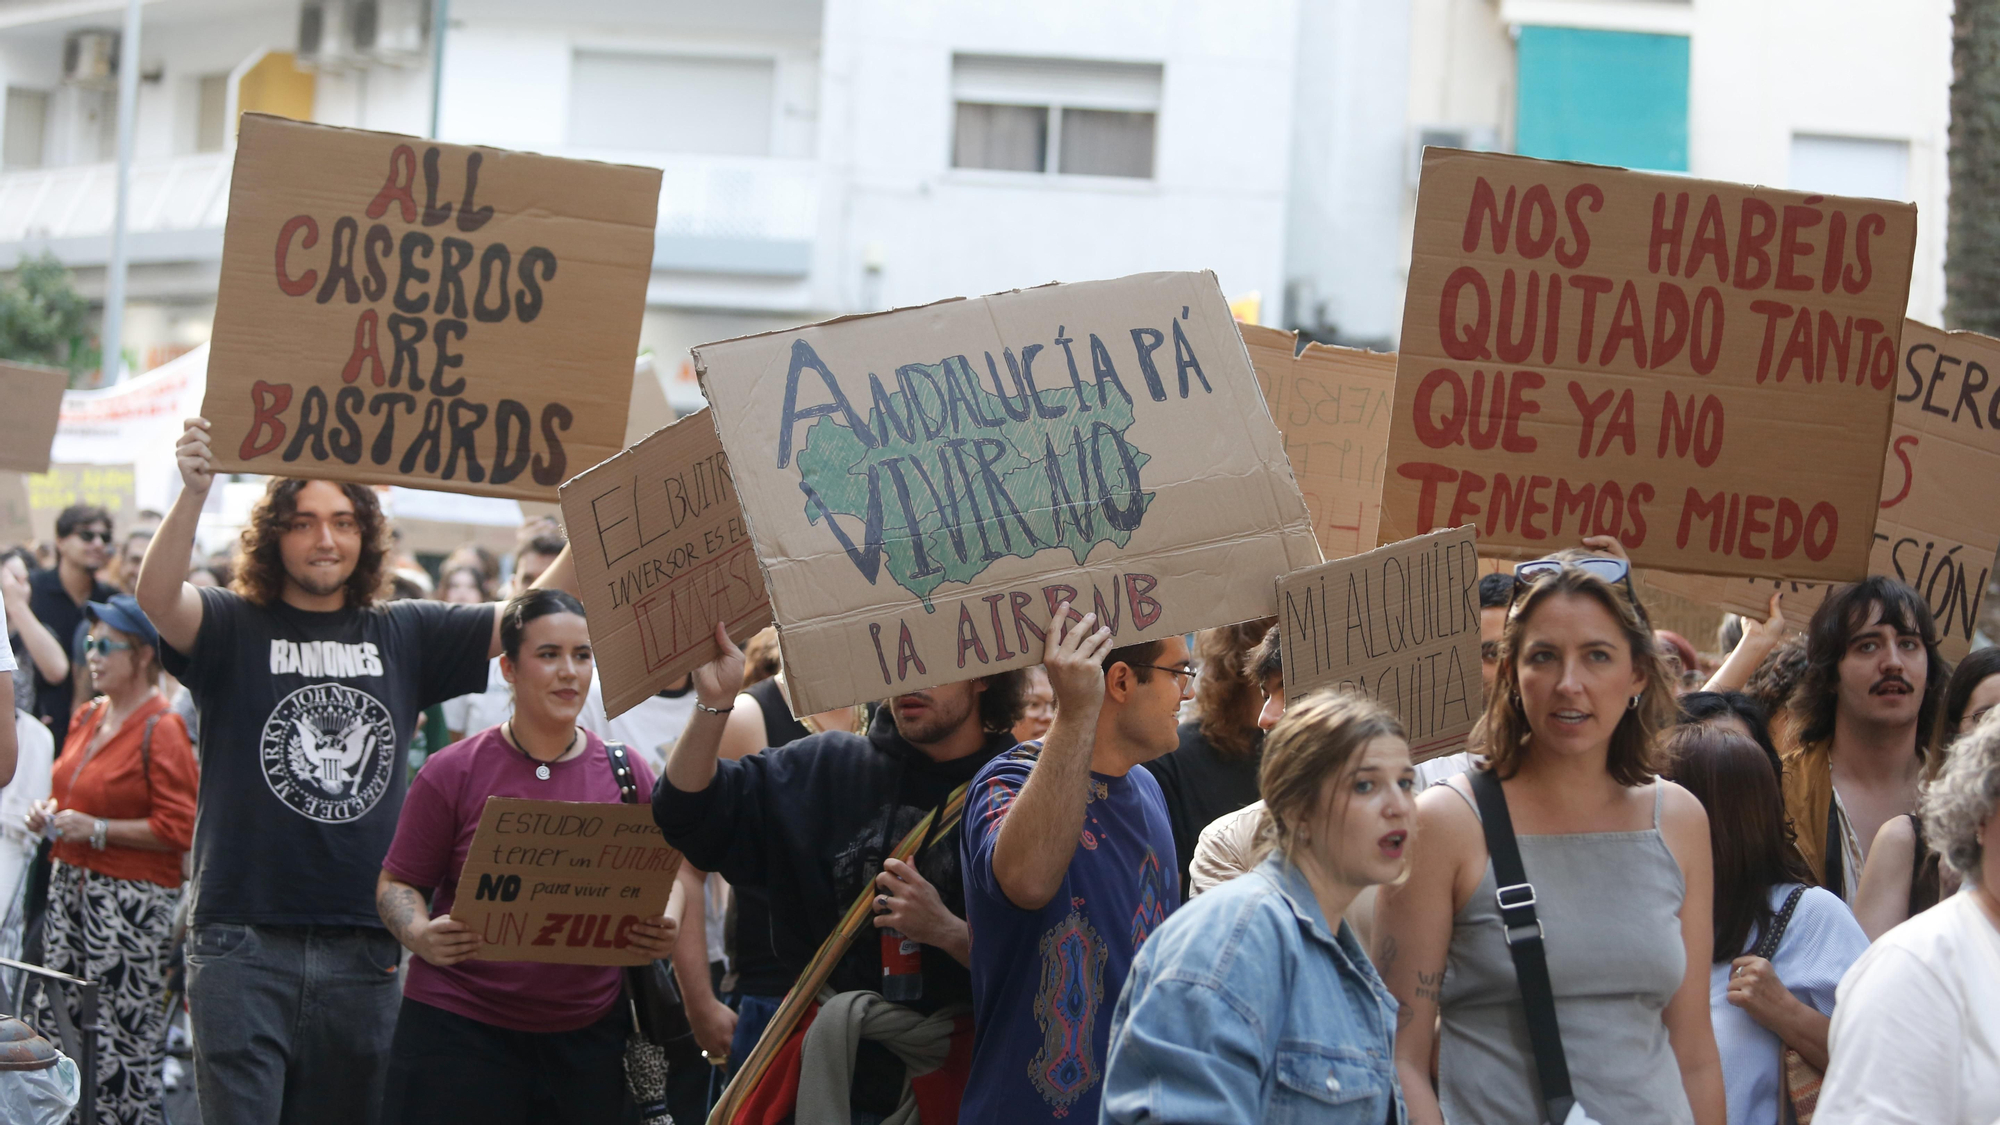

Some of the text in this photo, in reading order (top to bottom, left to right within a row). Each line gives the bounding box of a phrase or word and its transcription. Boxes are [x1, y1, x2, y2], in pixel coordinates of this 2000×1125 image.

[365, 144, 494, 232] ALL
[275, 215, 557, 323] CASEROS
[1462, 176, 1885, 295] NOS HABÉIS
[342, 309, 468, 397] ARE
[1438, 266, 1896, 390] QUITADO TANTO
[777, 306, 1212, 468] ANDALUCÍA PÁ
[1413, 368, 1725, 468] QUE YA NO
[239, 380, 573, 486] BASTARDS
[591, 475, 670, 569] EL
[799, 438, 1038, 585] VIVIR
[1045, 421, 1144, 543] NO
[1397, 462, 1655, 550] TENEMOS
[1676, 487, 1839, 562] MIEDO
[608, 516, 750, 610] INVERSOR ES EL
[270, 639, 384, 678] RAMONES
[869, 618, 926, 685] PA
[291, 686, 375, 714] JOHNNY
[264, 713, 295, 798] MARKY
[493, 844, 569, 866] tener
[569, 857, 591, 868] un
[495, 812, 603, 838] ESTUDIO
[475, 873, 641, 902] NO para vivir en
[483, 912, 528, 946] UN
